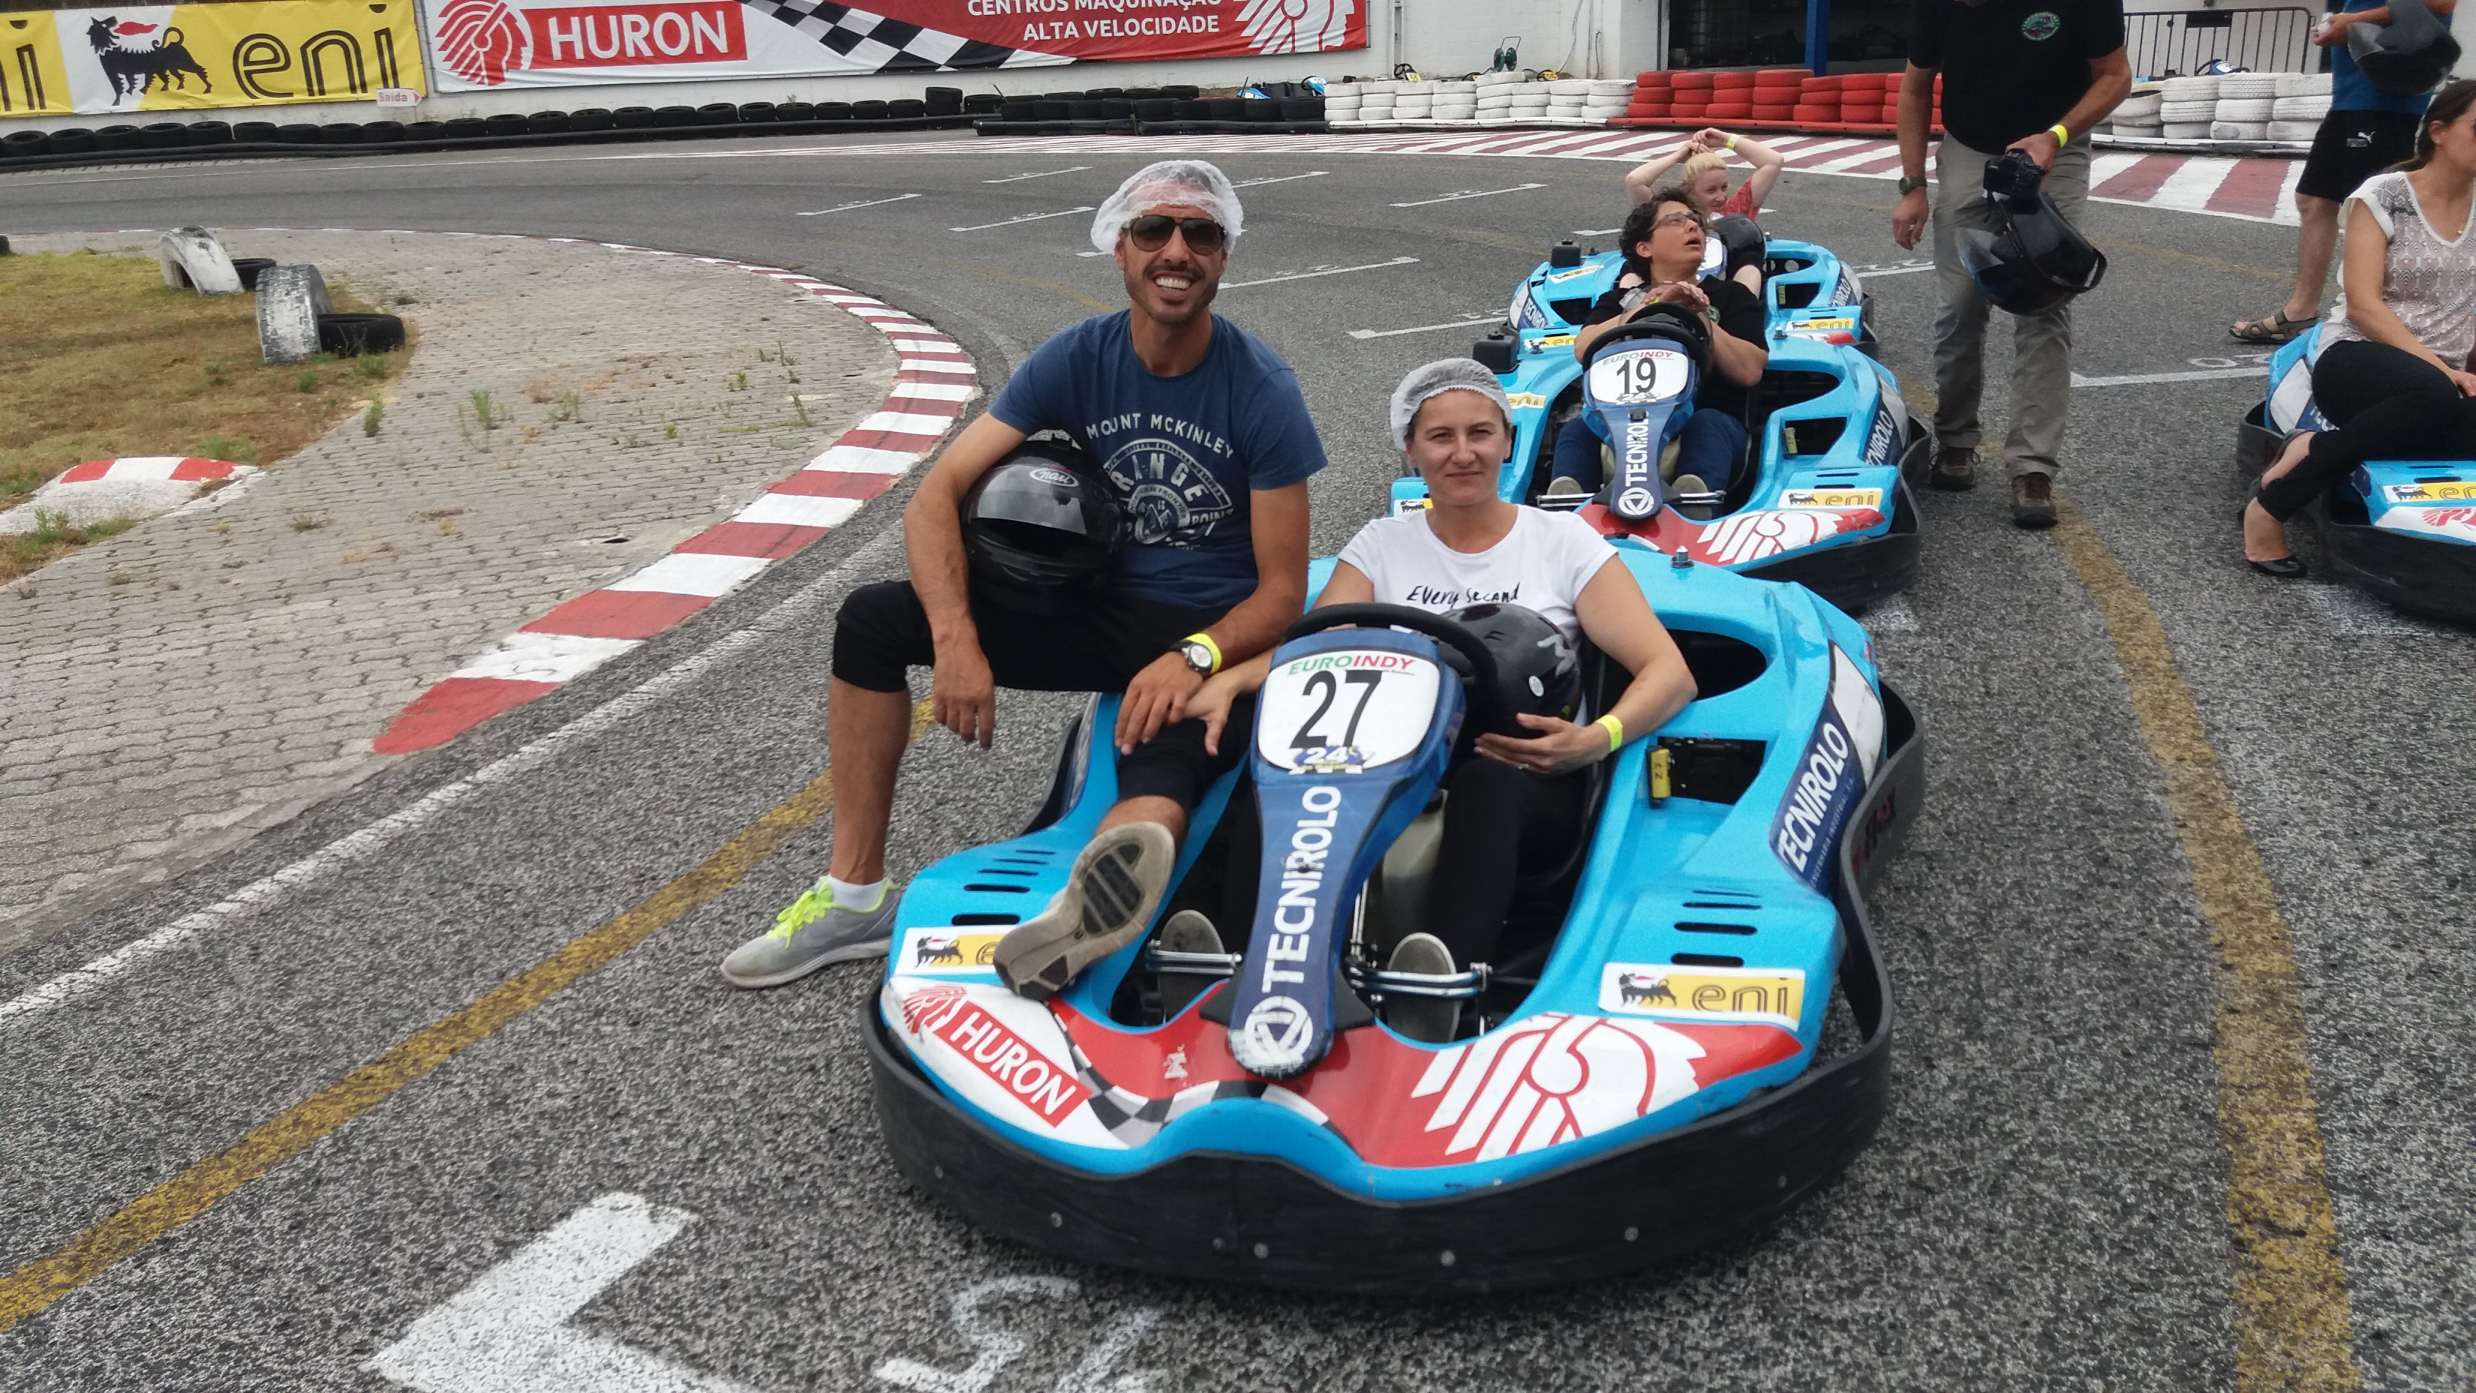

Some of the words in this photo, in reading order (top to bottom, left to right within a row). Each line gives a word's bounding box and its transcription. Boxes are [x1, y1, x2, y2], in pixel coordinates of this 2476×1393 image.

[968, 0, 1069, 16] CENTROS
[1023, 21, 1080, 41] ALTA
[1083, 15, 1220, 38] VELOCIDADE
[232, 4, 400, 99] eni
[548, 11, 729, 61] HURON
[1616, 358, 1657, 394] 19
[1085, 412, 1141, 440] MOUNT
[1150, 413, 1234, 459] MCKINLEY
[1625, 411, 1649, 487] TECNIROL
[1824, 491, 1873, 506] eni
[1288, 655, 1415, 676] EUROINDY
[1289, 669, 1383, 749] 27
[1262, 785, 1342, 993] TECNIROLO
[1691, 977, 1789, 1017] eni
[949, 1011, 1077, 1116] HURON
